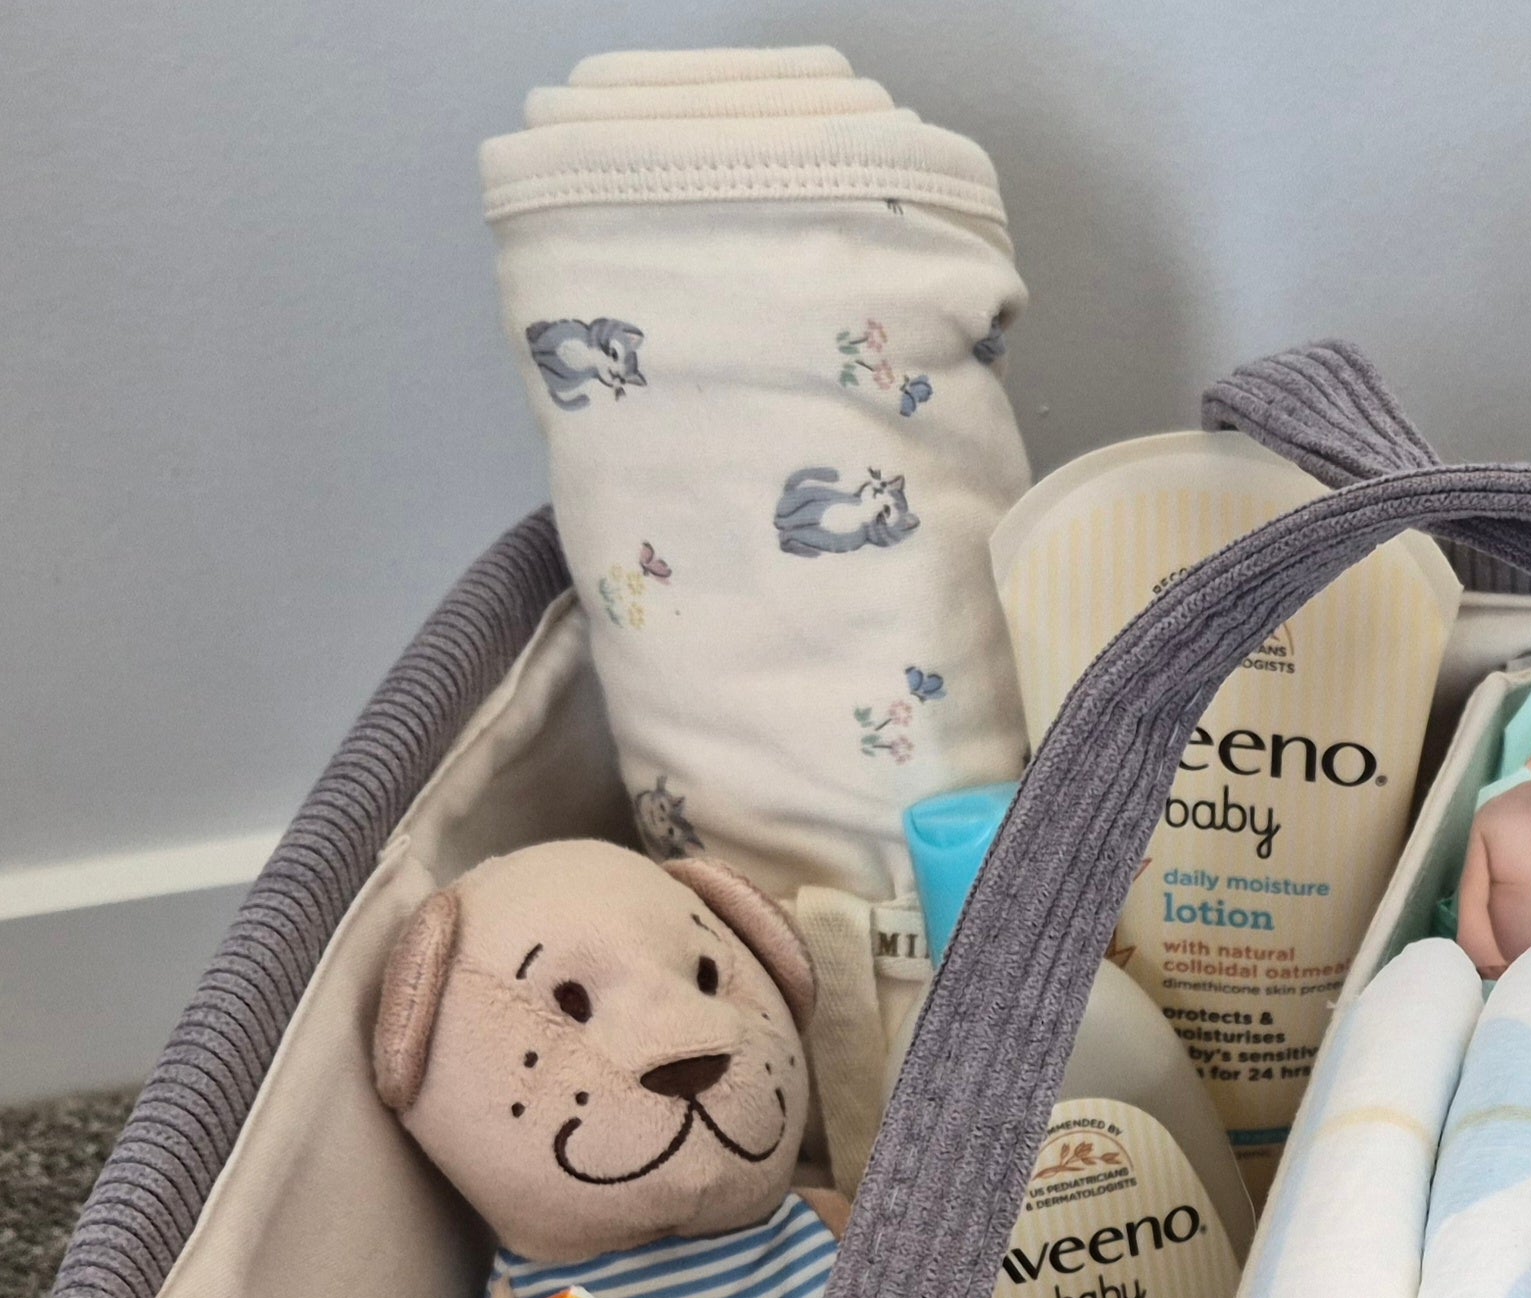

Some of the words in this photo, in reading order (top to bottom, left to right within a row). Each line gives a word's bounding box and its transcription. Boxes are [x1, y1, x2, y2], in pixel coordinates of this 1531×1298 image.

[1163, 868, 1219, 891] daily
[1226, 875, 1331, 897] moisture
[1163, 892, 1275, 931] lotion
[877, 931, 929, 959] MI
[1163, 940, 1210, 956] with
[1218, 945, 1296, 962] natural
[1163, 960, 1258, 979] colloidal
[1163, 978, 1260, 995] dimethicone
[1265, 984, 1297, 995] skin
[1259, 1012, 1274, 1025] &
[1210, 1066, 1241, 1081] for
[1248, 1067, 1274, 1081] 24
[1107, 1123, 1122, 1136] BY
[1029, 1187, 1045, 1198] US
[1046, 1167, 1129, 1193] PEDIATRICIANS
[1036, 1178, 1138, 1209] DERMATOLOGISTS
